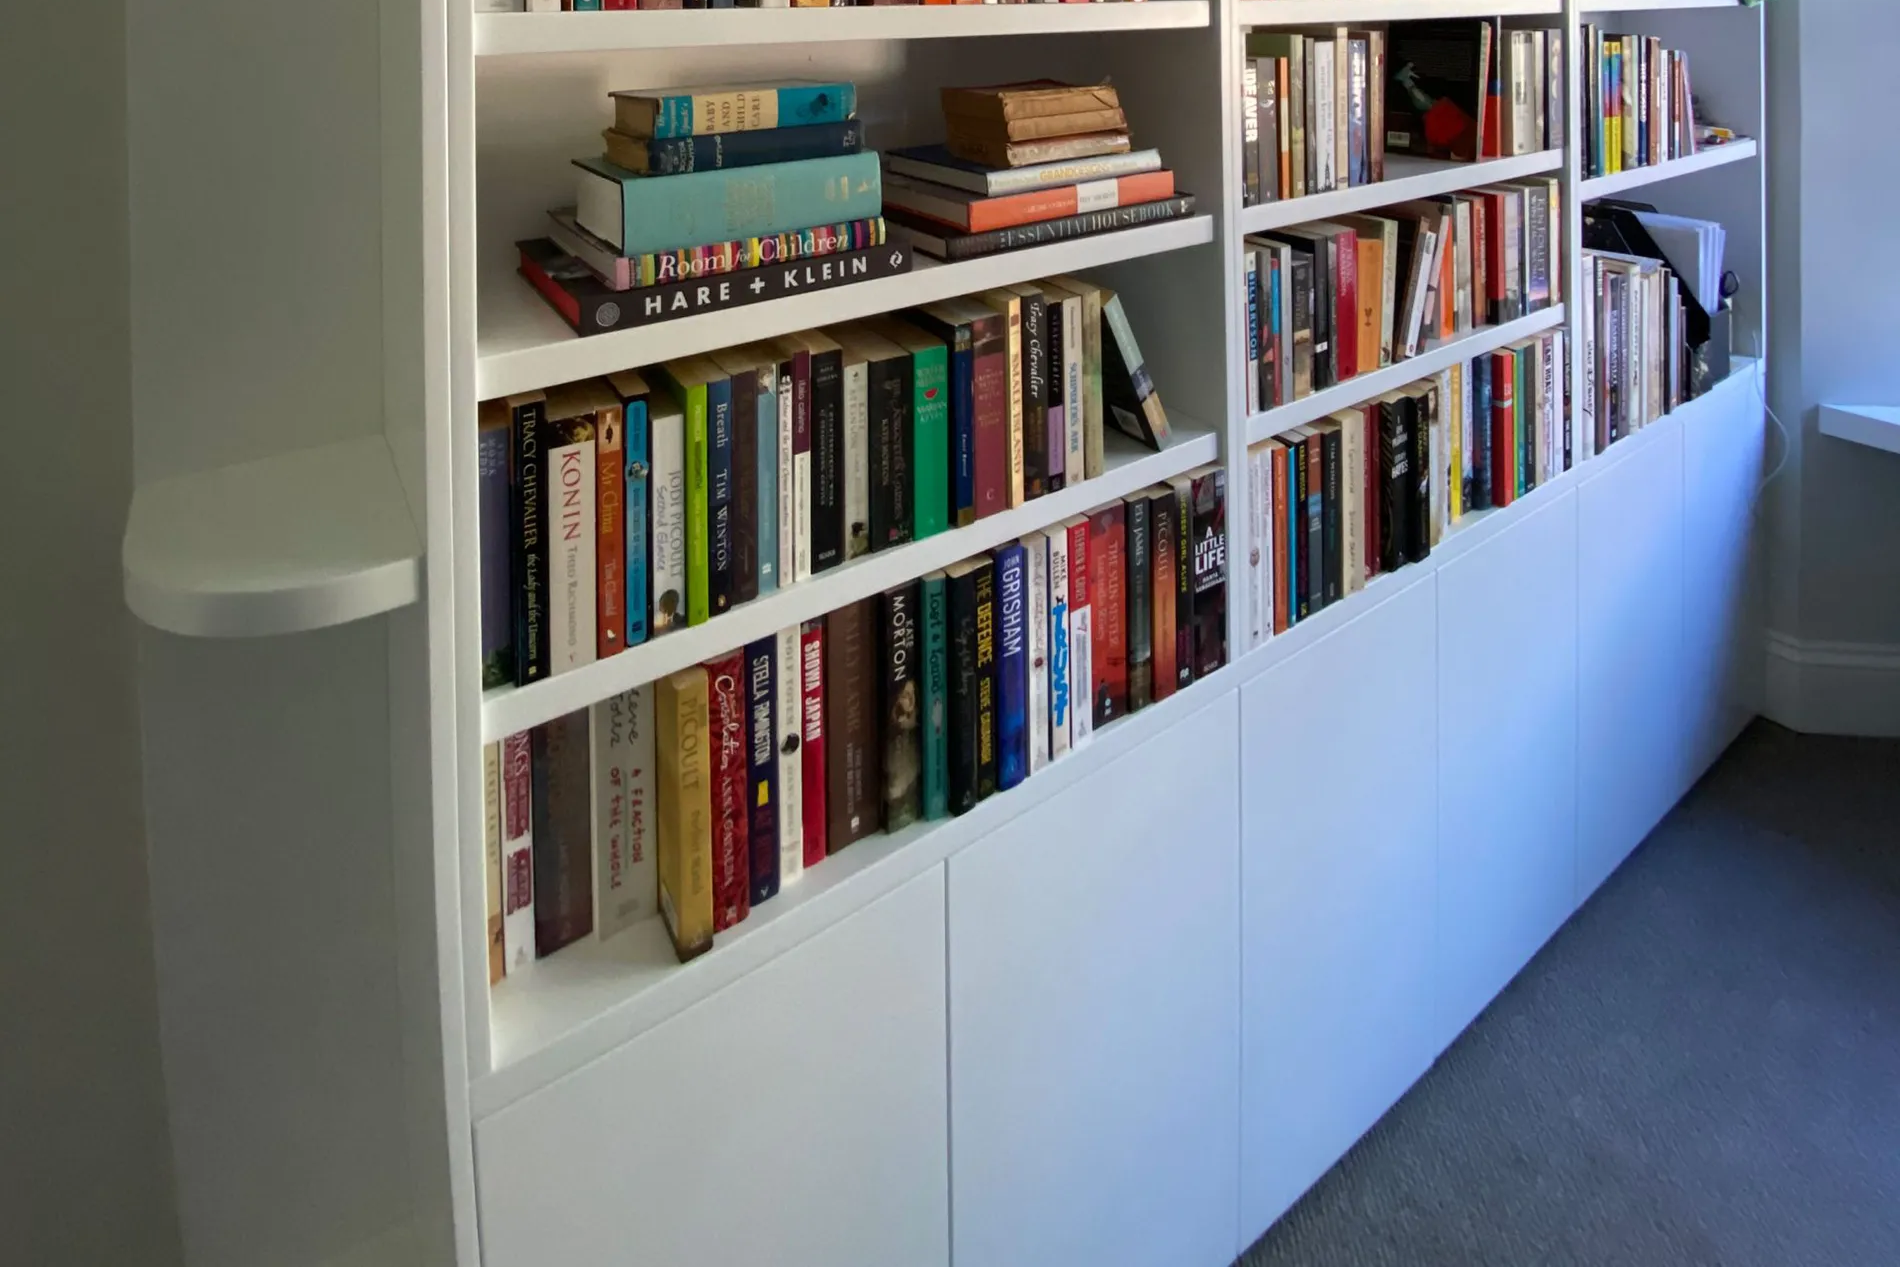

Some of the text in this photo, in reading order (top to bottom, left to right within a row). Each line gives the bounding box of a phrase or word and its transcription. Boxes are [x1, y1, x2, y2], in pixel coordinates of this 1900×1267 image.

[705, 99, 715, 132] BABY
[721, 100, 731, 127] AND
[736, 93, 746, 131] CHILD
[751, 95, 760, 127] CARE
[1245, 74, 1258, 142] DEAVER
[1092, 200, 1174, 232] HOUSEBOOK
[645, 257, 867, 316] HARE + KLEIN
[659, 234, 848, 280] Room for Children
[1026, 302, 1043, 398] Tracy Chevalier
[1248, 273, 1257, 360] BILL BRYSON
[798, 380, 806, 433] italo calvino
[1011, 354, 1022, 474] SMALL ISLAND
[1070, 431, 1079, 453] ARK
[523, 410, 536, 548] TRACY CHEVALIER
[561, 452, 581, 541] KONIN
[602, 491, 618, 534] China
[716, 403, 728, 571] Breath TIM WINTON
[668, 470, 684, 578] JODI PICOULT
[1133, 527, 1144, 567] JAMES
[1180, 538, 1188, 561] GIRL
[1194, 536, 1225, 555] LITTLE
[1206, 526, 1213, 537] A
[1052, 551, 1060, 590] BULLEN
[1108, 541, 1119, 649] THE SUN SISTER
[1195, 554, 1225, 575] LIFE
[523, 554, 538, 660] the Lady and the Unicorn
[892, 595, 905, 681] MORTON
[905, 619, 914, 648] KATE
[976, 574, 992, 668] THE DEFENCE
[1002, 566, 1021, 657] GRISHAM
[714, 675, 740, 770] Consolation
[753, 654, 771, 766] STELLA RIMINGTON
[804, 639, 821, 742] SHOWA JAPAN
[980, 677, 991, 708] STEVE
[680, 698, 699, 791] PICOULT
[609, 767, 622, 891] OF THE WHOLE
[630, 788, 645, 863] FRACTION
